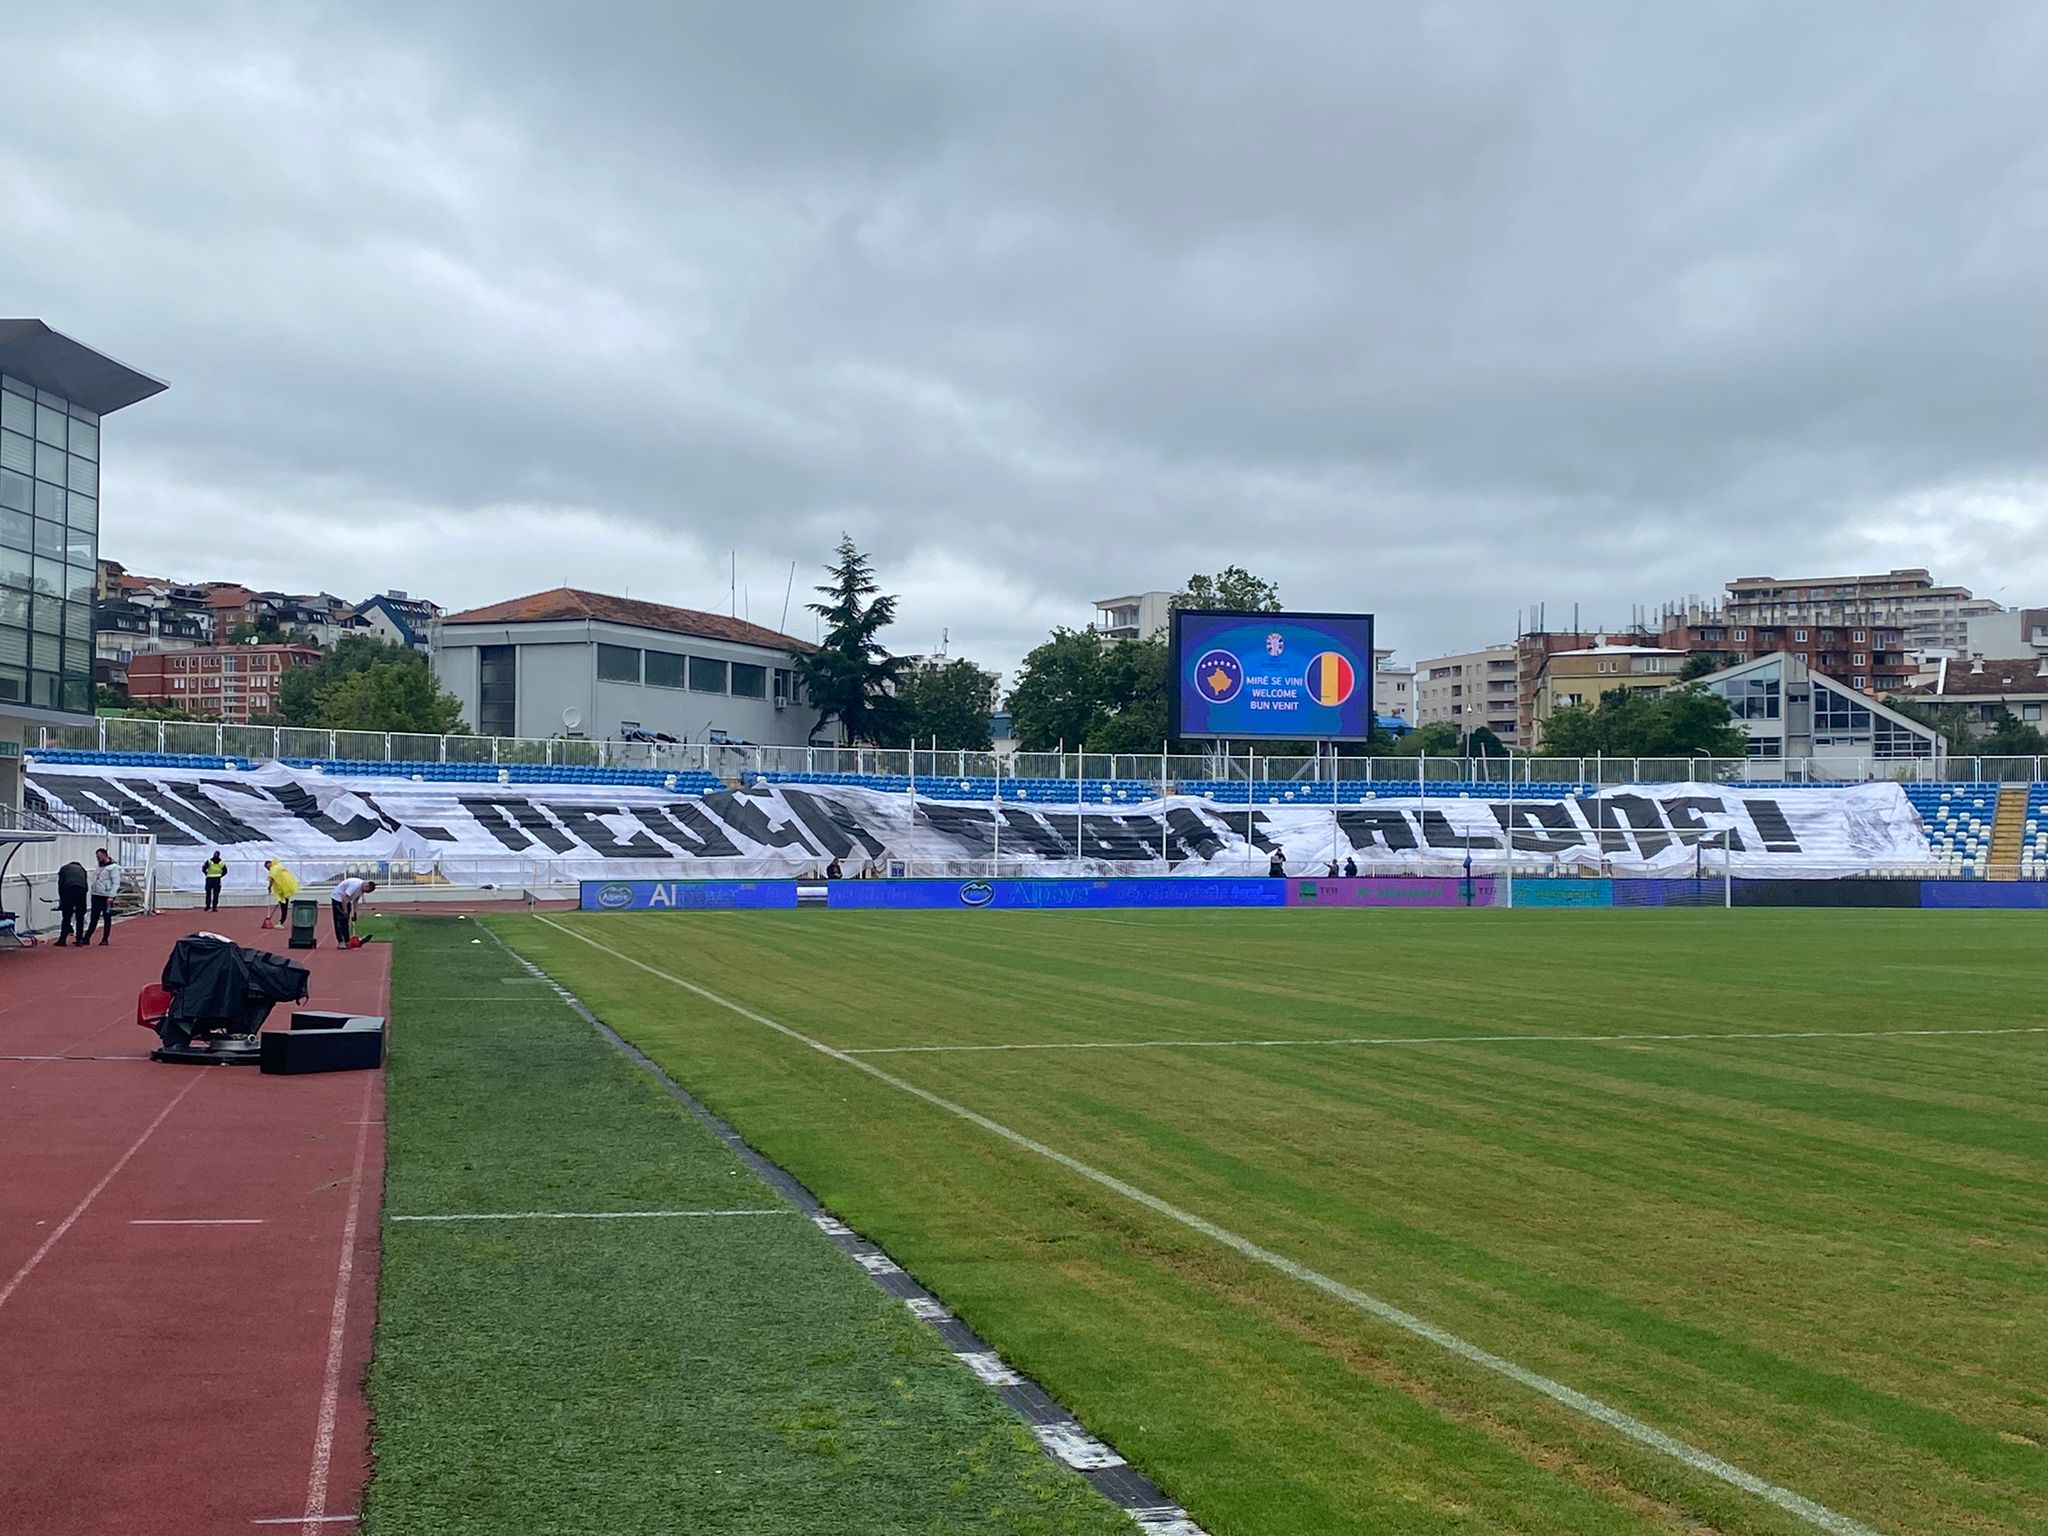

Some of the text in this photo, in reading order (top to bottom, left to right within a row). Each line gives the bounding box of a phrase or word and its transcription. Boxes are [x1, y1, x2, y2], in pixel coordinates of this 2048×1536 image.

[1271, 676, 1282, 686] SE
[1284, 677, 1303, 686] VINI
[1252, 688, 1297, 698] WELCOME
[1250, 700, 1299, 710] BUN VENIT
